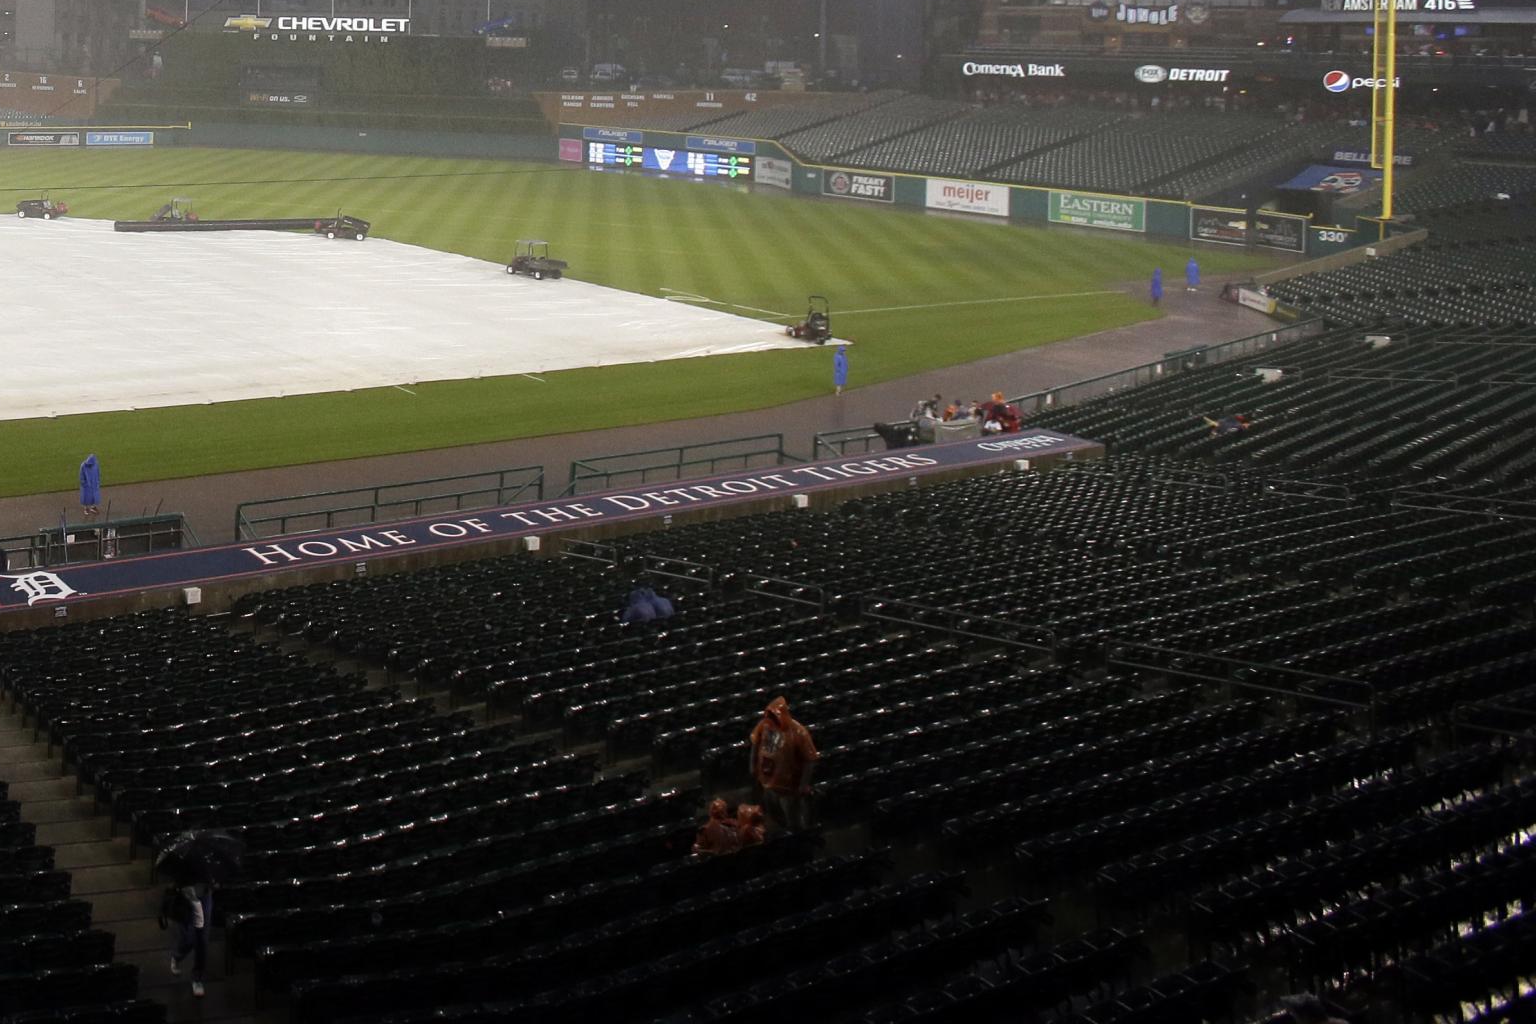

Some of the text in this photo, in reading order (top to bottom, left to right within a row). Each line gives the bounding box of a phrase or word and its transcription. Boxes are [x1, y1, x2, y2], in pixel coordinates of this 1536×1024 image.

[277, 16, 410, 32] CHEVROLET
[253, 33, 390, 43] FOUNTAIN
[1027, 63, 1066, 77] Bank
[1168, 67, 1230, 82] DETROIT
[1351, 77, 1400, 89] pepi
[744, 92, 758, 102] 42
[852, 175, 886, 186] FREAKY
[851, 184, 885, 197] FAST!
[943, 183, 991, 203] meijer
[1060, 192, 1135, 215] EASTERN
[240, 452, 940, 566] HOME OF THE DETROIT TIGERS
